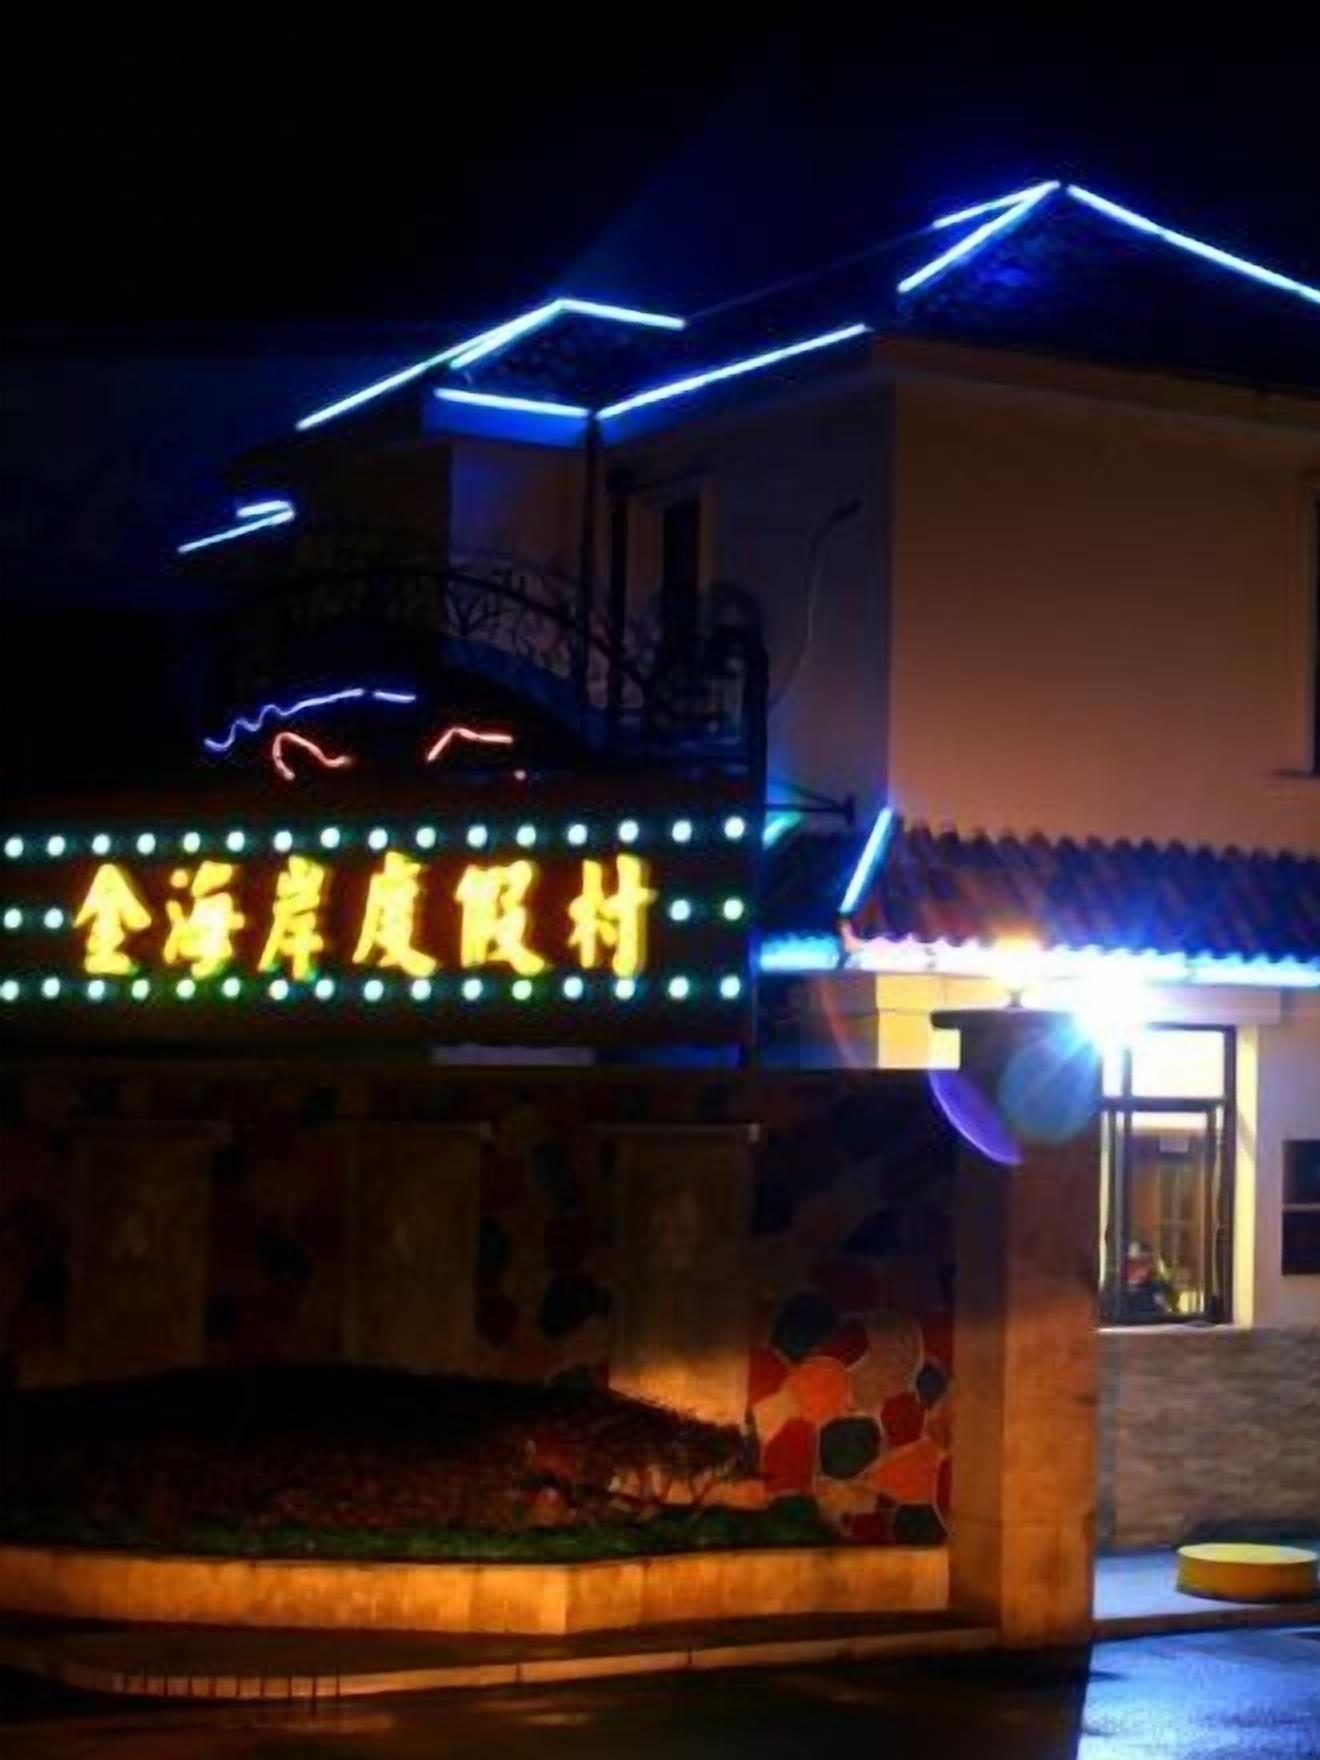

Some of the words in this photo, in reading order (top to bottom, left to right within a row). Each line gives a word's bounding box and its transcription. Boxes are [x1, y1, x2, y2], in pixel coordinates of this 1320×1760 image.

[73, 853, 655, 980] 金海岸度假村
